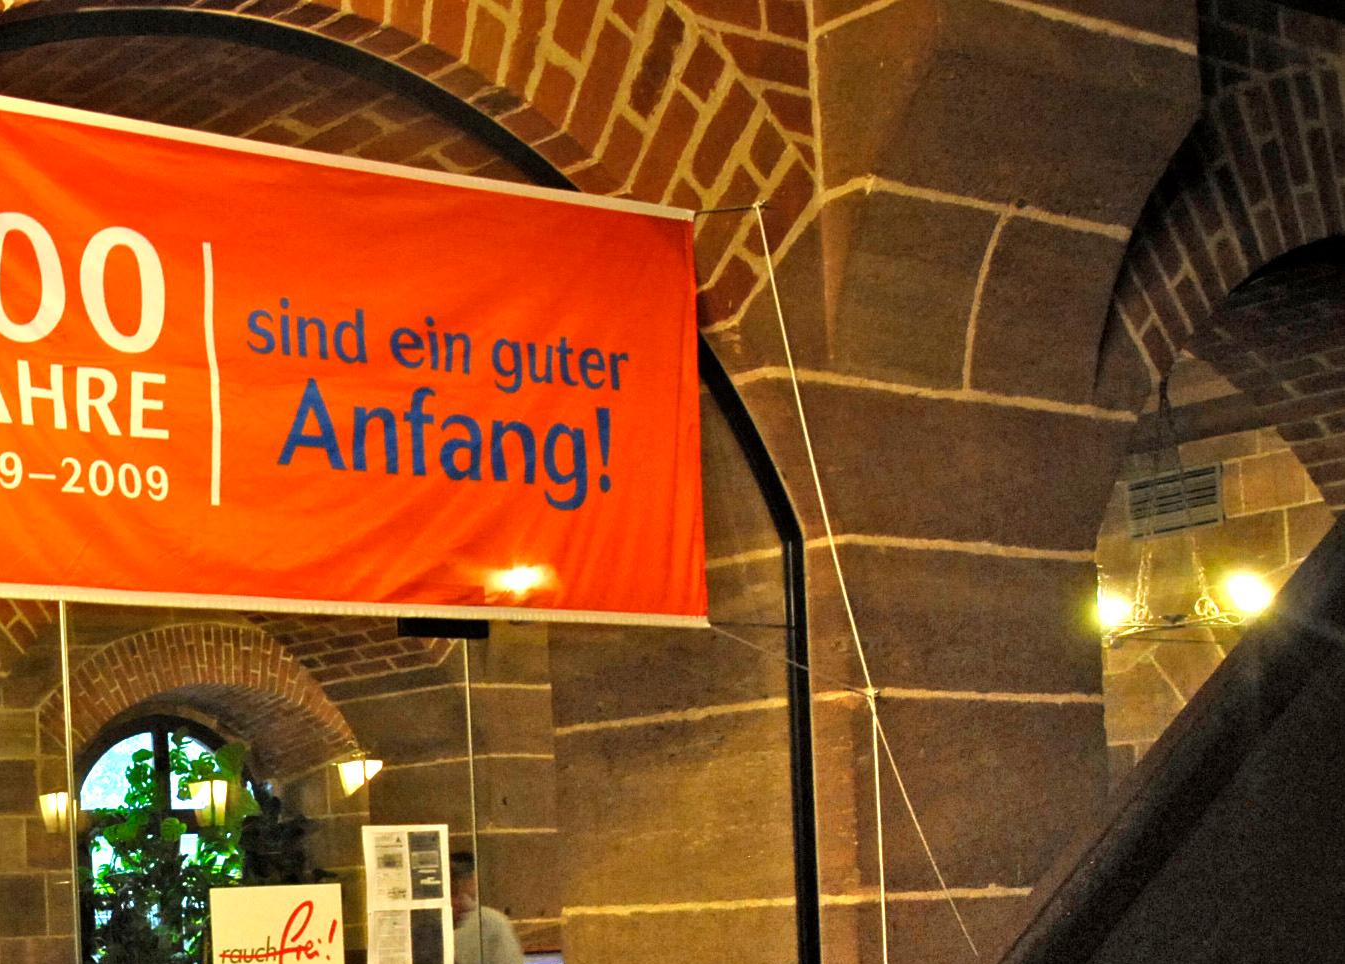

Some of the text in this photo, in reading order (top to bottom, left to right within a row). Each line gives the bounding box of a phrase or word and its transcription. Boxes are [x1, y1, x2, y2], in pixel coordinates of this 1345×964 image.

[246, 298, 628, 395] sind ein guter
[276, 378, 612, 512] Anfang!
